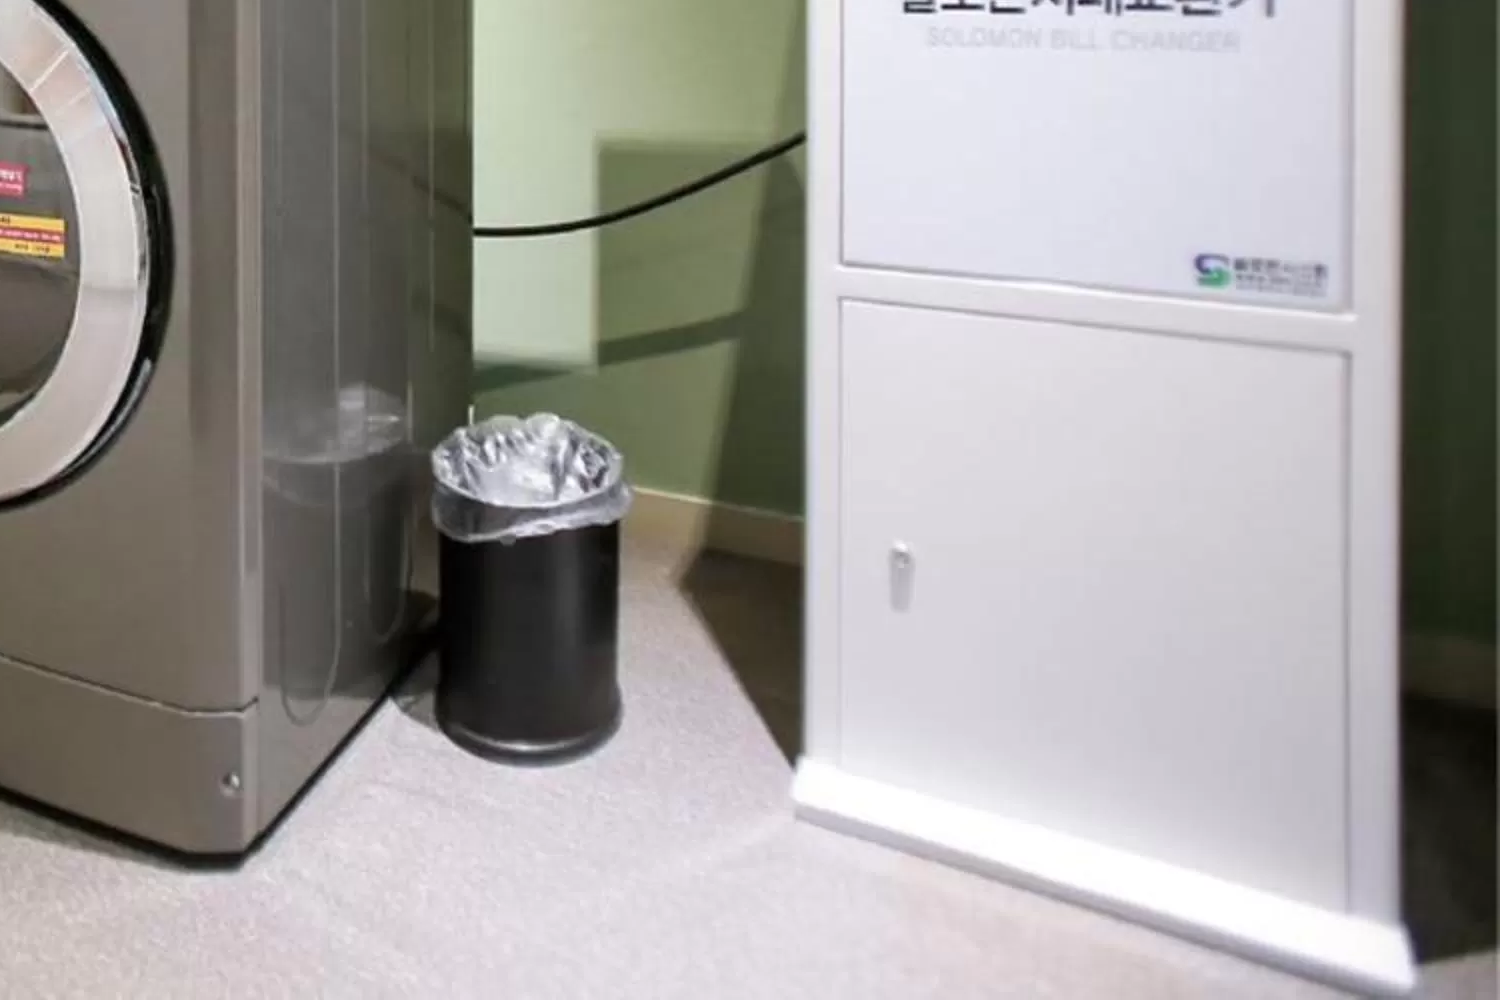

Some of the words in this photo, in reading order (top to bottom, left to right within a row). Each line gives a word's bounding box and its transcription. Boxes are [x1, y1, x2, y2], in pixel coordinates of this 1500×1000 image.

[926, 26, 1043, 50] SOLOMON
[1050, 28, 1098, 50] BILL
[1111, 29, 1241, 53] CHANGER
